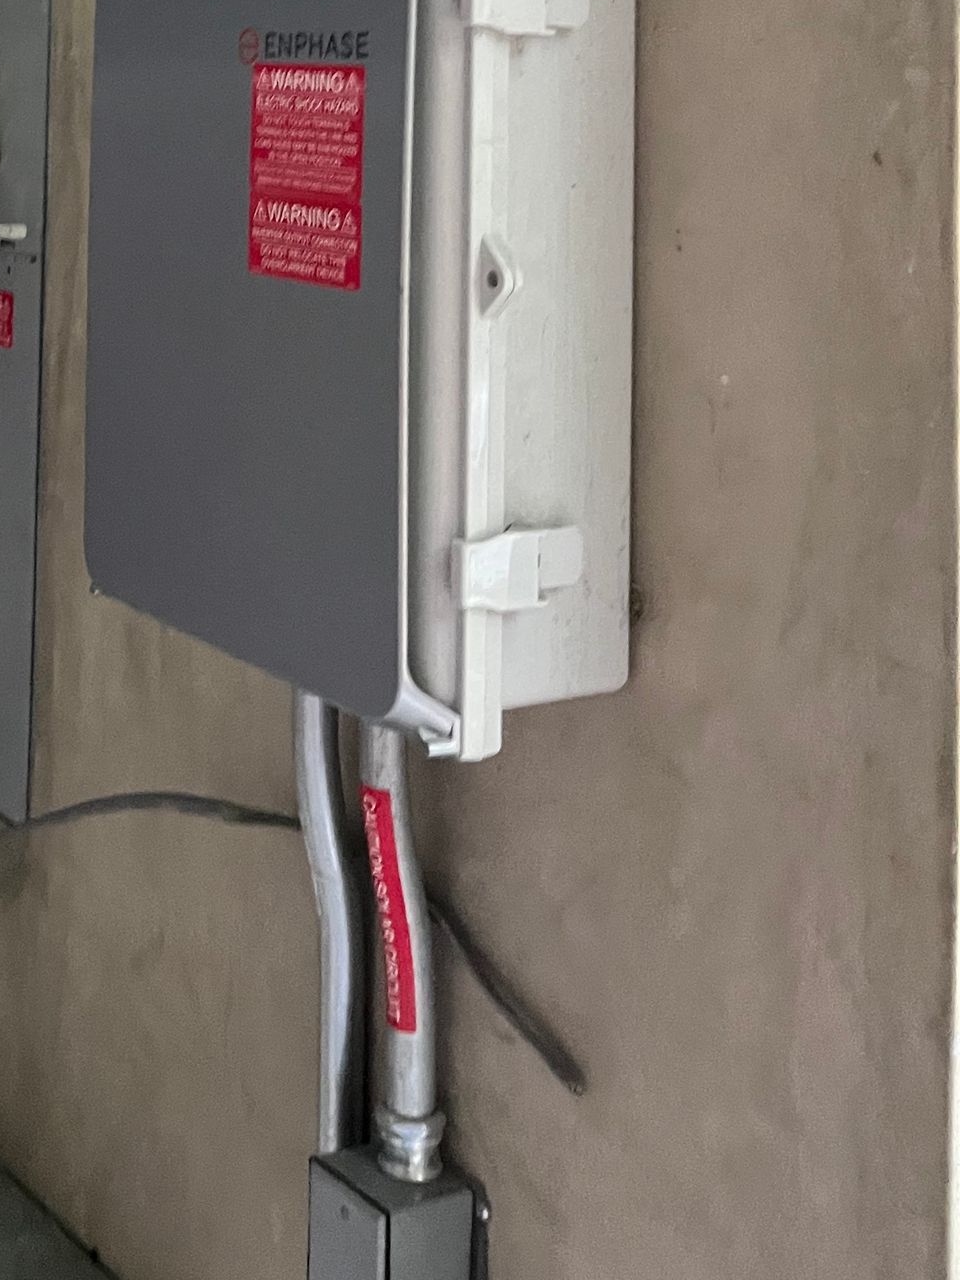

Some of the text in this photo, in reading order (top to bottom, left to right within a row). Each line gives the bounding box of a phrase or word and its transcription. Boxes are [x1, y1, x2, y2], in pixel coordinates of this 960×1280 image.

[263, 30, 371, 61] ENPHASE
[270, 67, 345, 93] WARNING
[268, 200, 340, 231] WARNING
